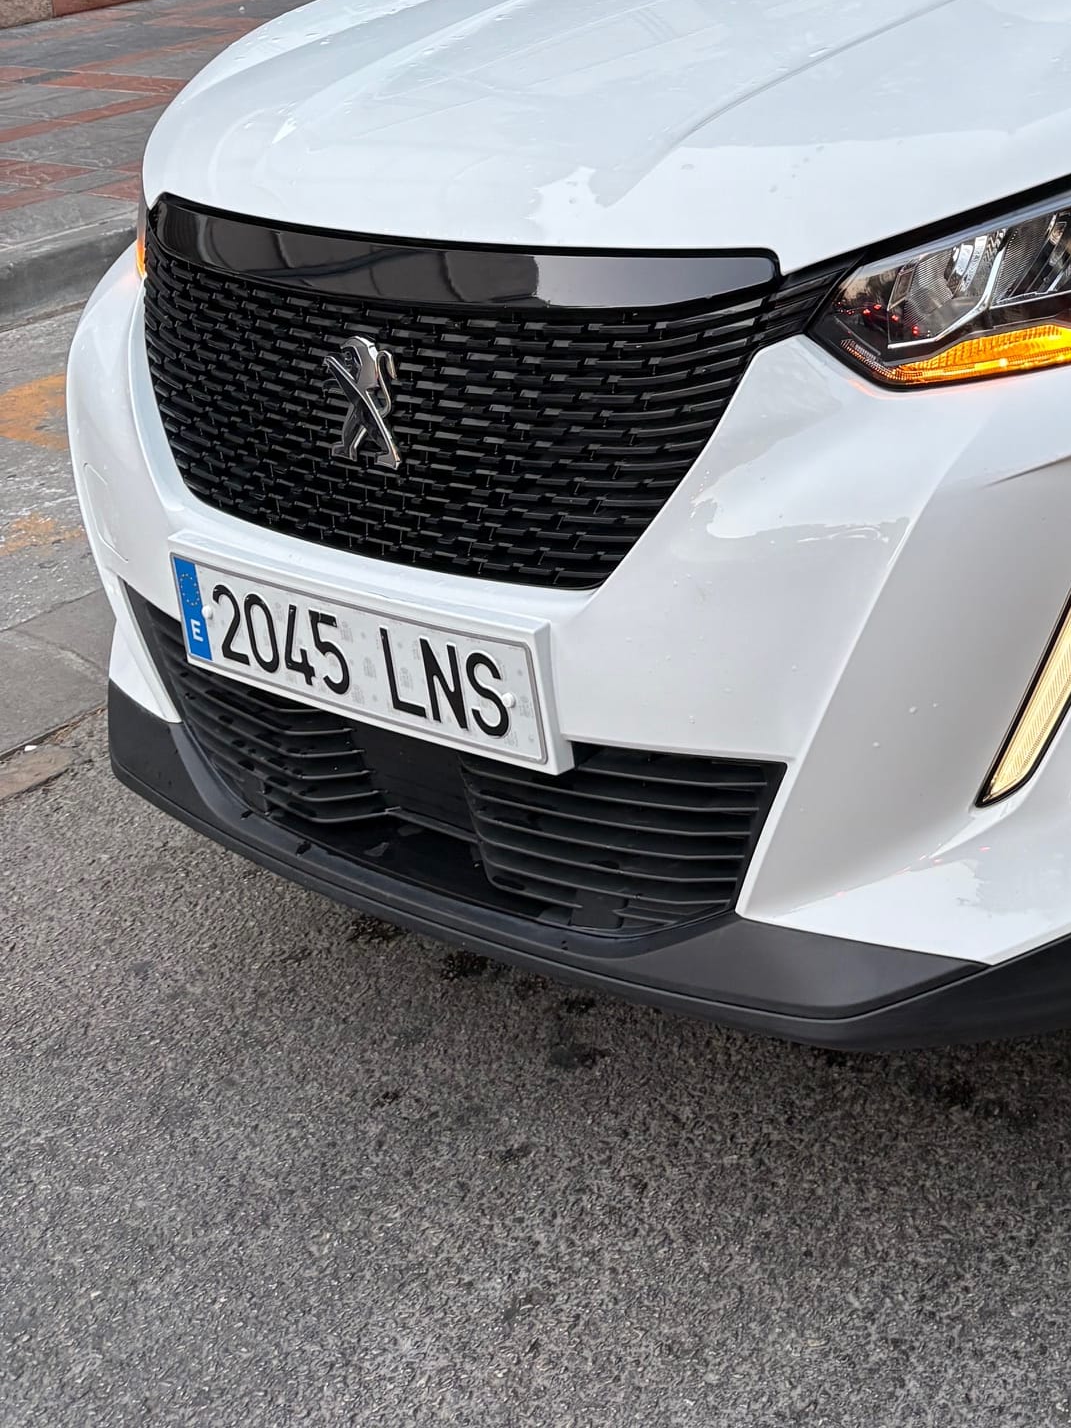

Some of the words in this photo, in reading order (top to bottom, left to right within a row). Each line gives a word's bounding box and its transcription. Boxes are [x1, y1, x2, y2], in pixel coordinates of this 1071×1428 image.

[190, 618, 204, 642] E
[212, 584, 350, 695] 2045
[379, 627, 510, 737] LNS
